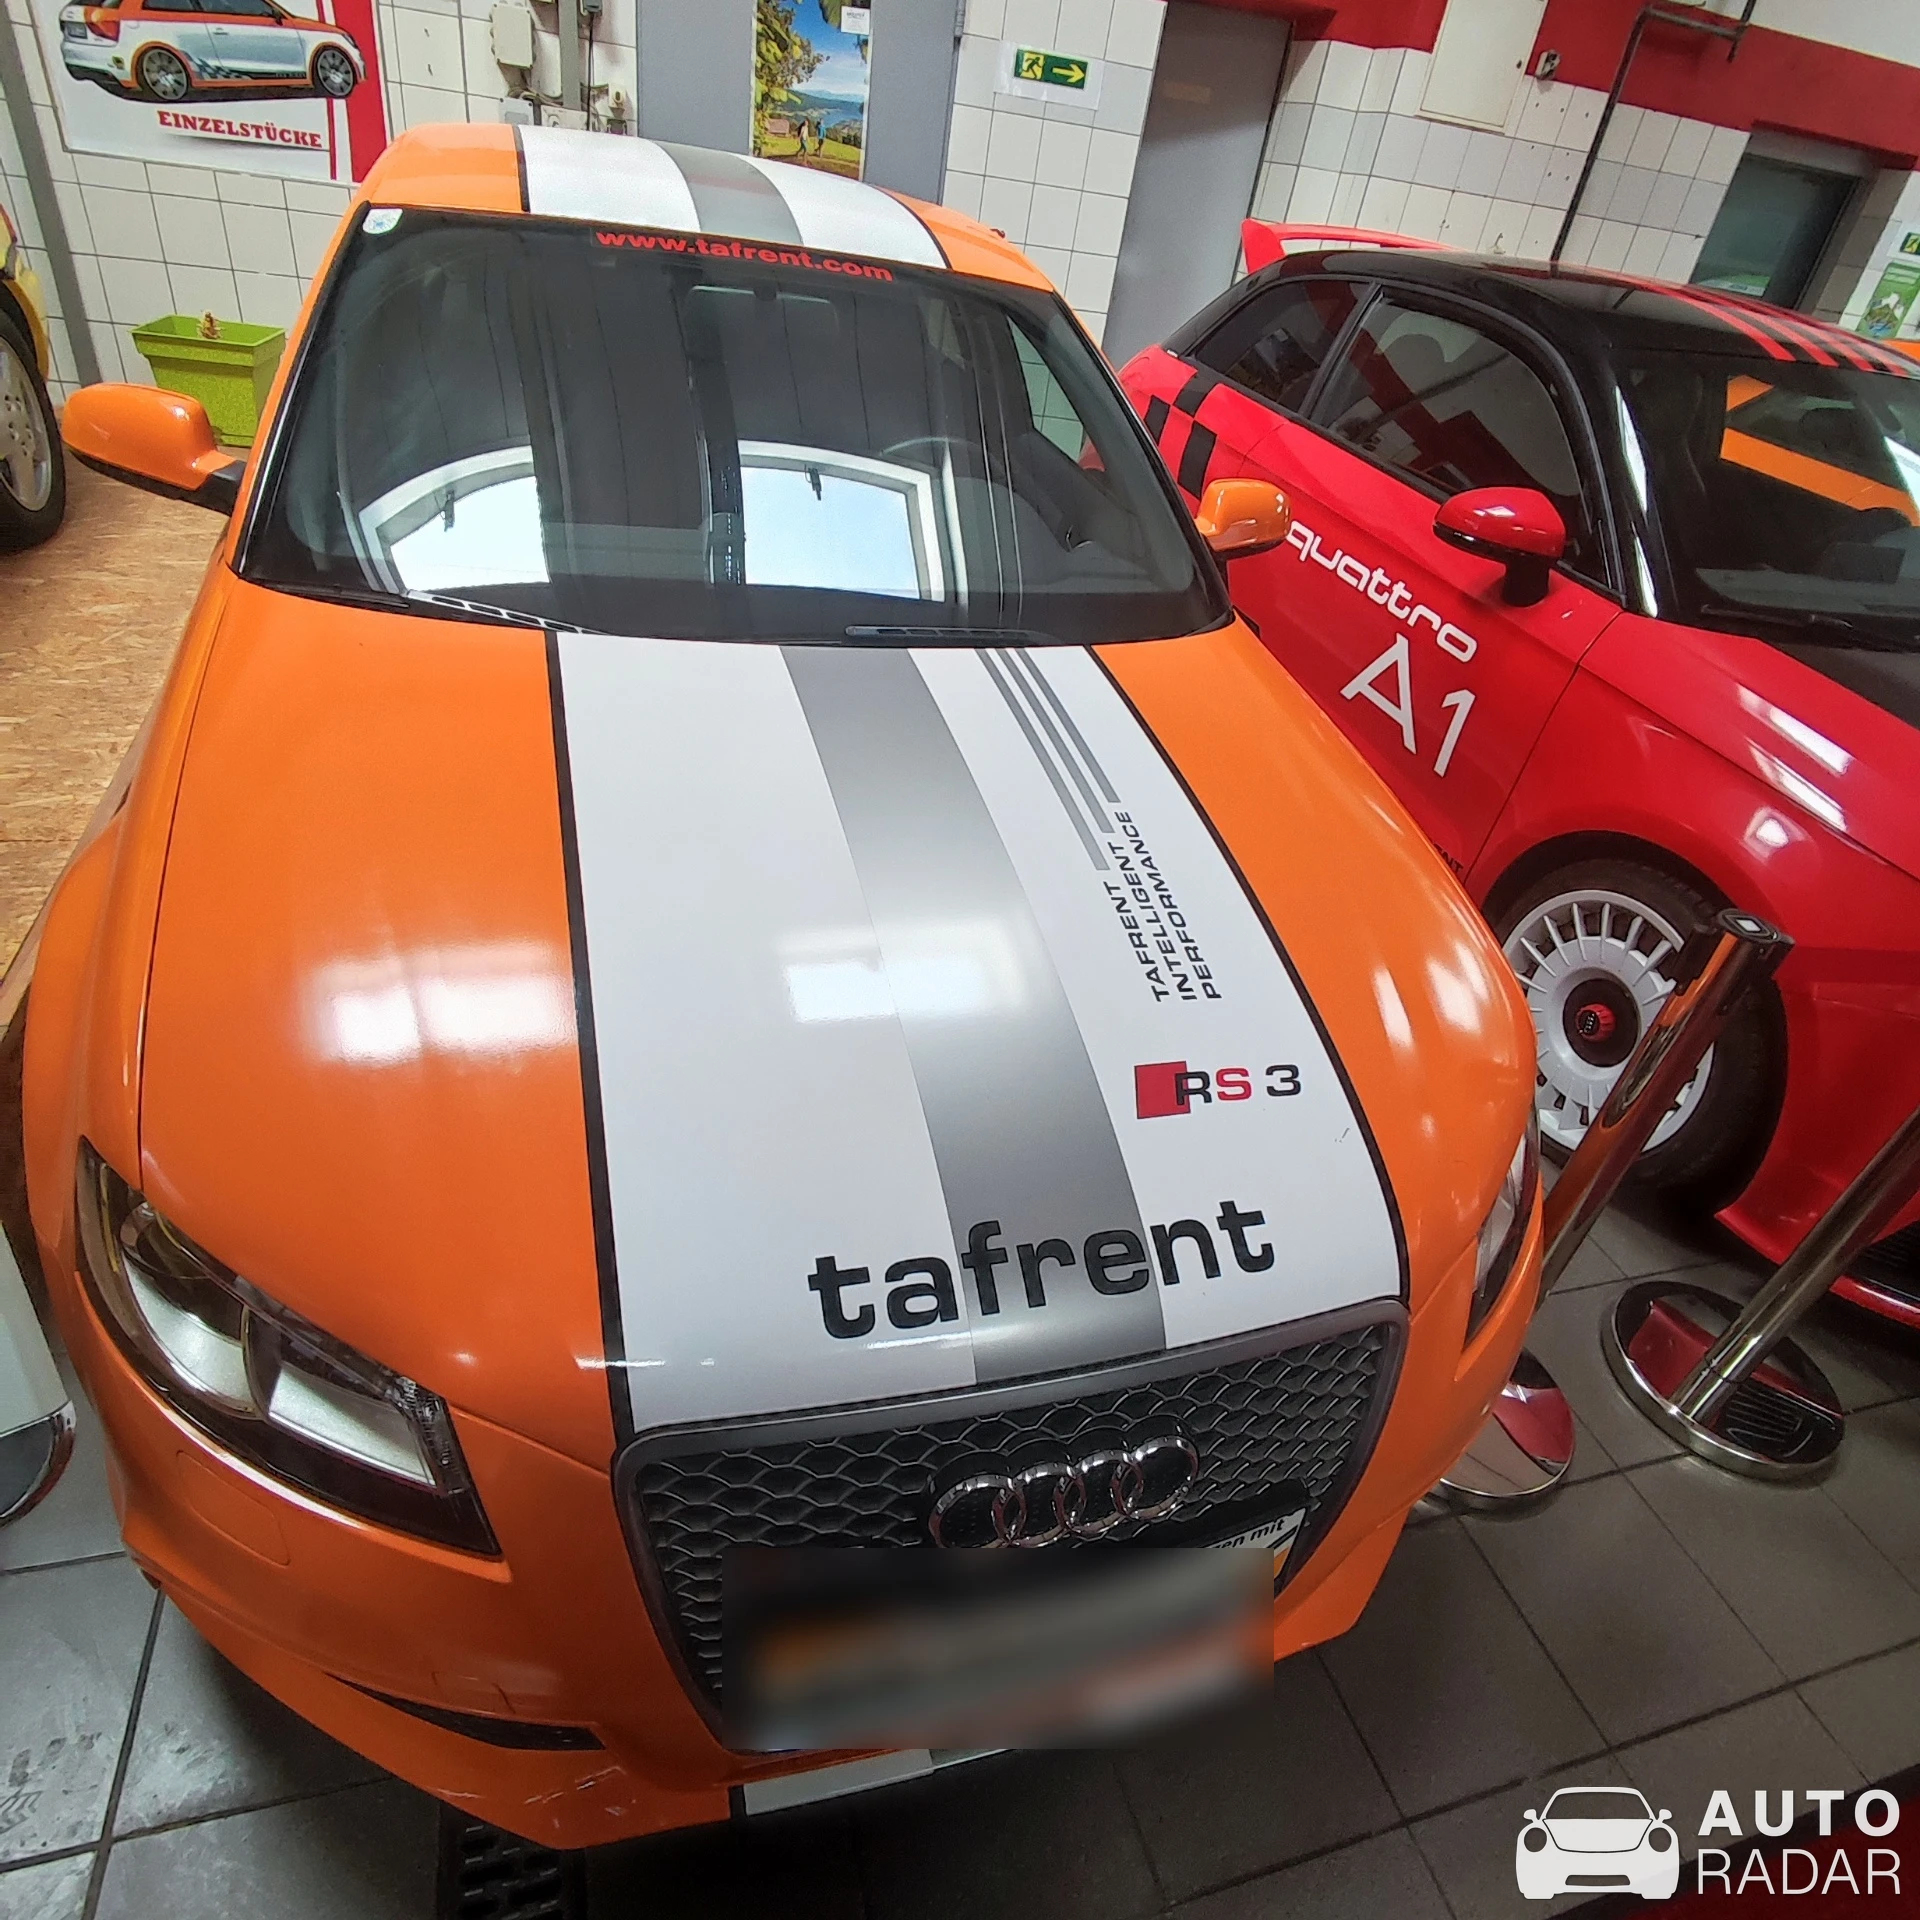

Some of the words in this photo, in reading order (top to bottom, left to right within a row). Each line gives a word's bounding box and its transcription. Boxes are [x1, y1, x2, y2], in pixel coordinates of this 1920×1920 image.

[157, 110, 323, 148] EINZELSTÜCKE
[596, 231, 893, 282] www.tafrent.com
[1286, 520, 1477, 662] quattro
[1340, 633, 1476, 777] A1
[1103, 881, 1170, 1002] TAFRENT
[1107, 842, 1197, 1000] INTELLIGENT
[1114, 811, 1222, 999] PERFORMANCE
[1174, 1068, 1253, 1106] RS
[1265, 1064, 1302, 1097] 3
[807, 1201, 1275, 1339] tafrent
[1250, 1518, 1285, 1541] mit
